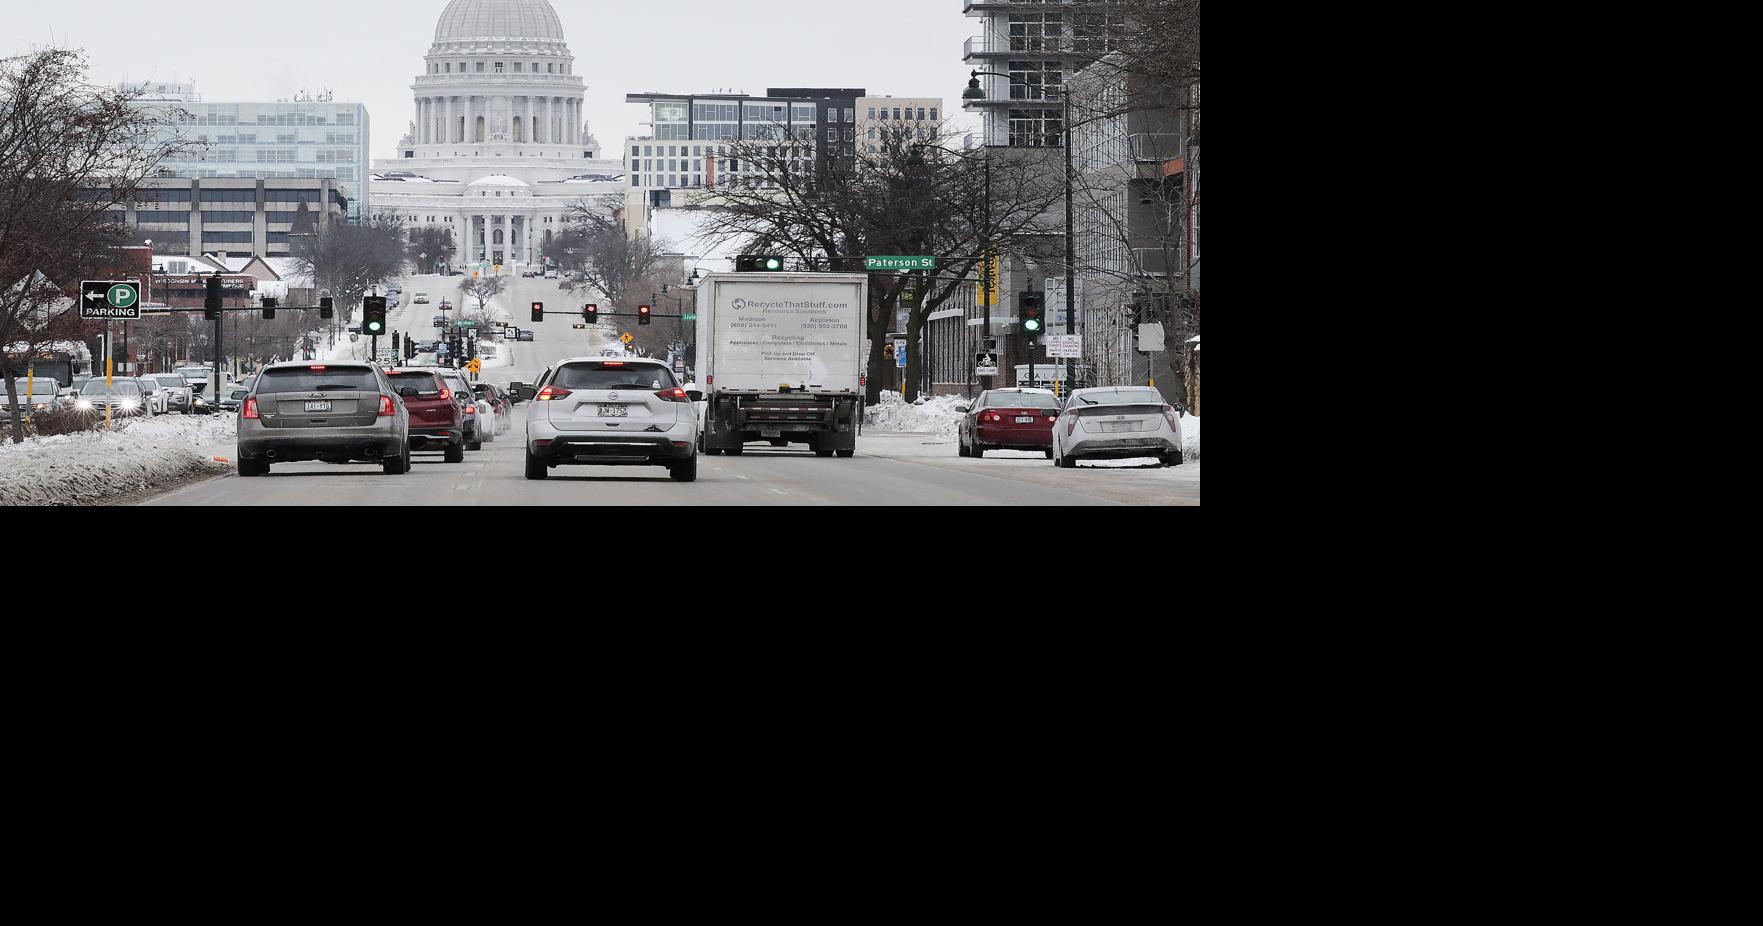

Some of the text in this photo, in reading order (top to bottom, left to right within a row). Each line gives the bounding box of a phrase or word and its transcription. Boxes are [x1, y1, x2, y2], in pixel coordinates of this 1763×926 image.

[868, 258, 933, 267] Paterson St
[115, 288, 131, 304] P
[747, 300, 848, 309] RecycleThatStuff.com
[86, 308, 135, 316] PARKING
[376, 357, 390, 365] 25
